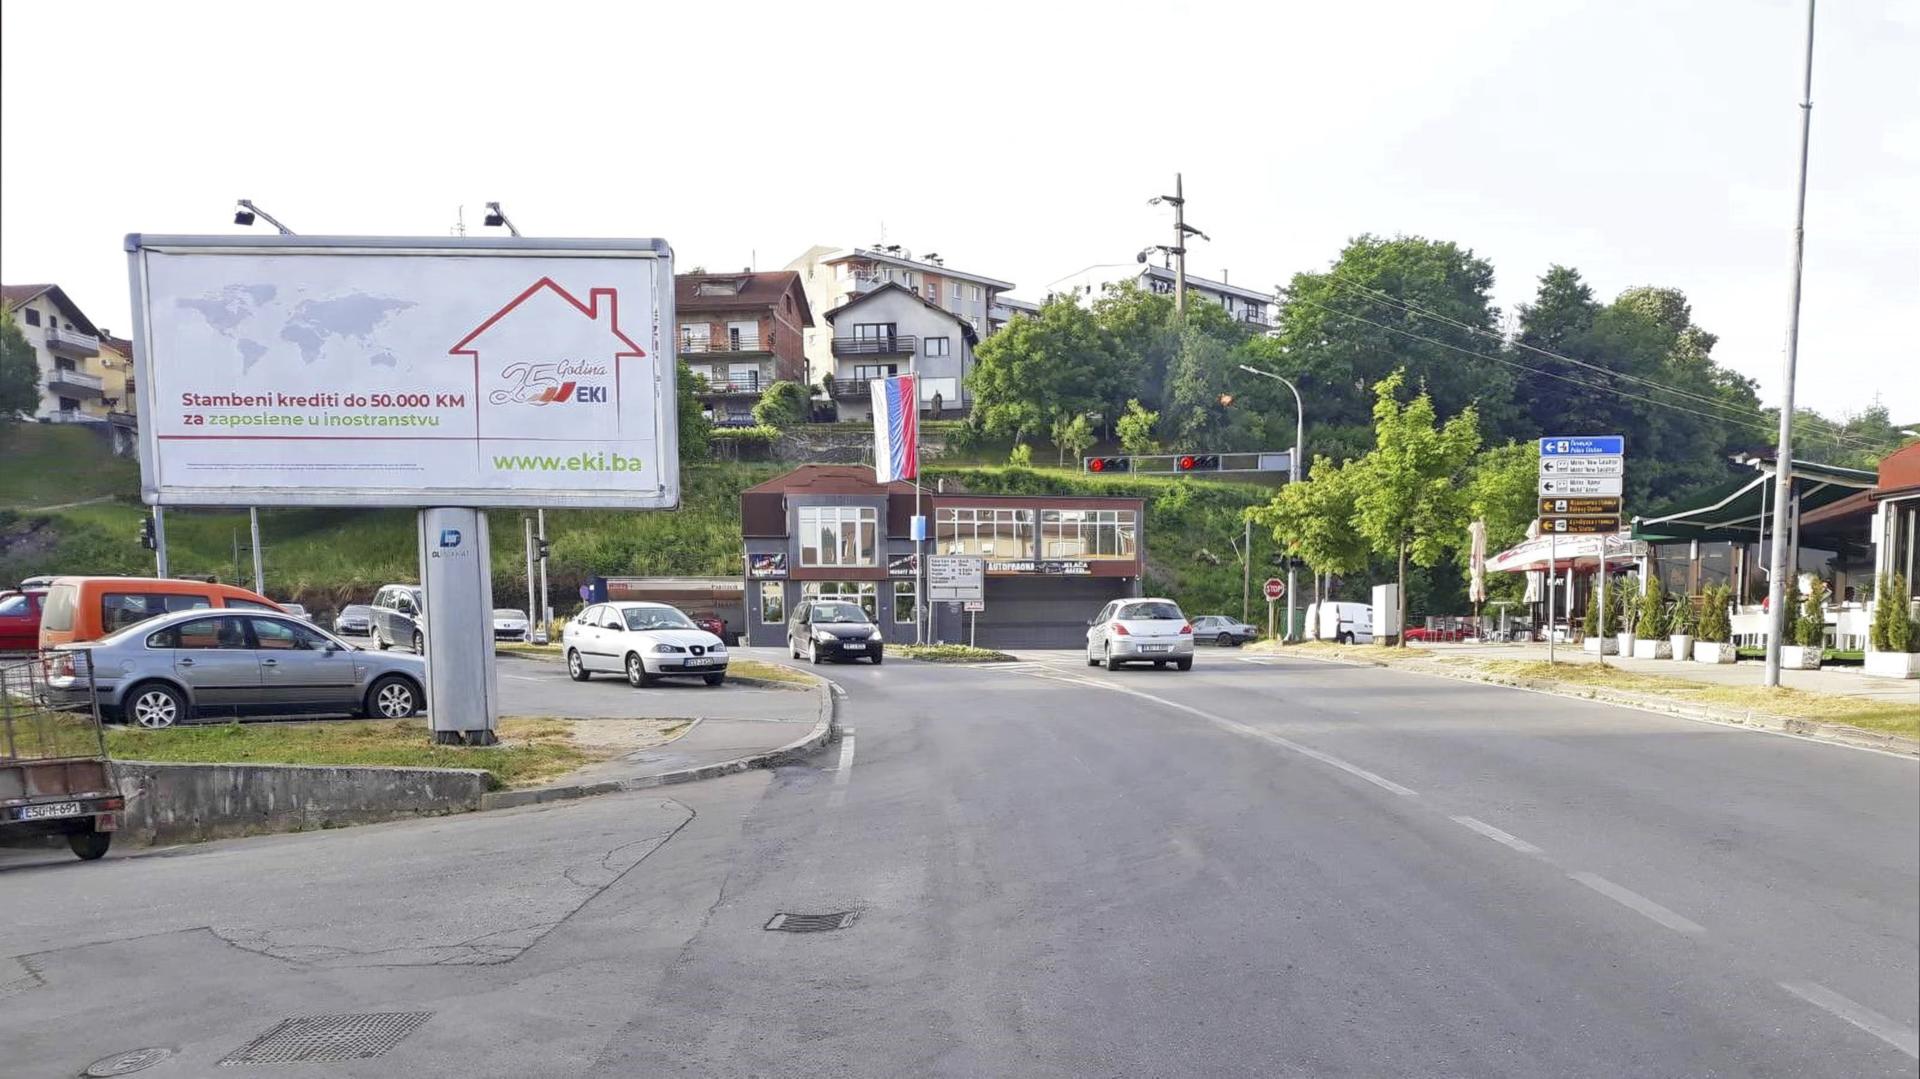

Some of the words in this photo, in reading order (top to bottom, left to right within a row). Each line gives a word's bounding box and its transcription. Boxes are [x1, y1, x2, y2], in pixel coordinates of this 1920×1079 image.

[557, 359, 608, 378] Godina
[489, 362, 559, 406] 25
[182, 392, 272, 407] Stambeni
[277, 393, 339, 408] krediti
[343, 393, 367, 408] do
[371, 394, 430, 408] 50.000
[436, 394, 465, 408] KM
[576, 386, 607, 403] EKI
[183, 414, 204, 426] za
[208, 411, 305, 428] zaposlene
[308, 415, 319, 427] u
[323, 412, 440, 427] inostranstvu
[492, 453, 642, 472] www.eki.ba
[1266, 584, 1283, 593] STOP
